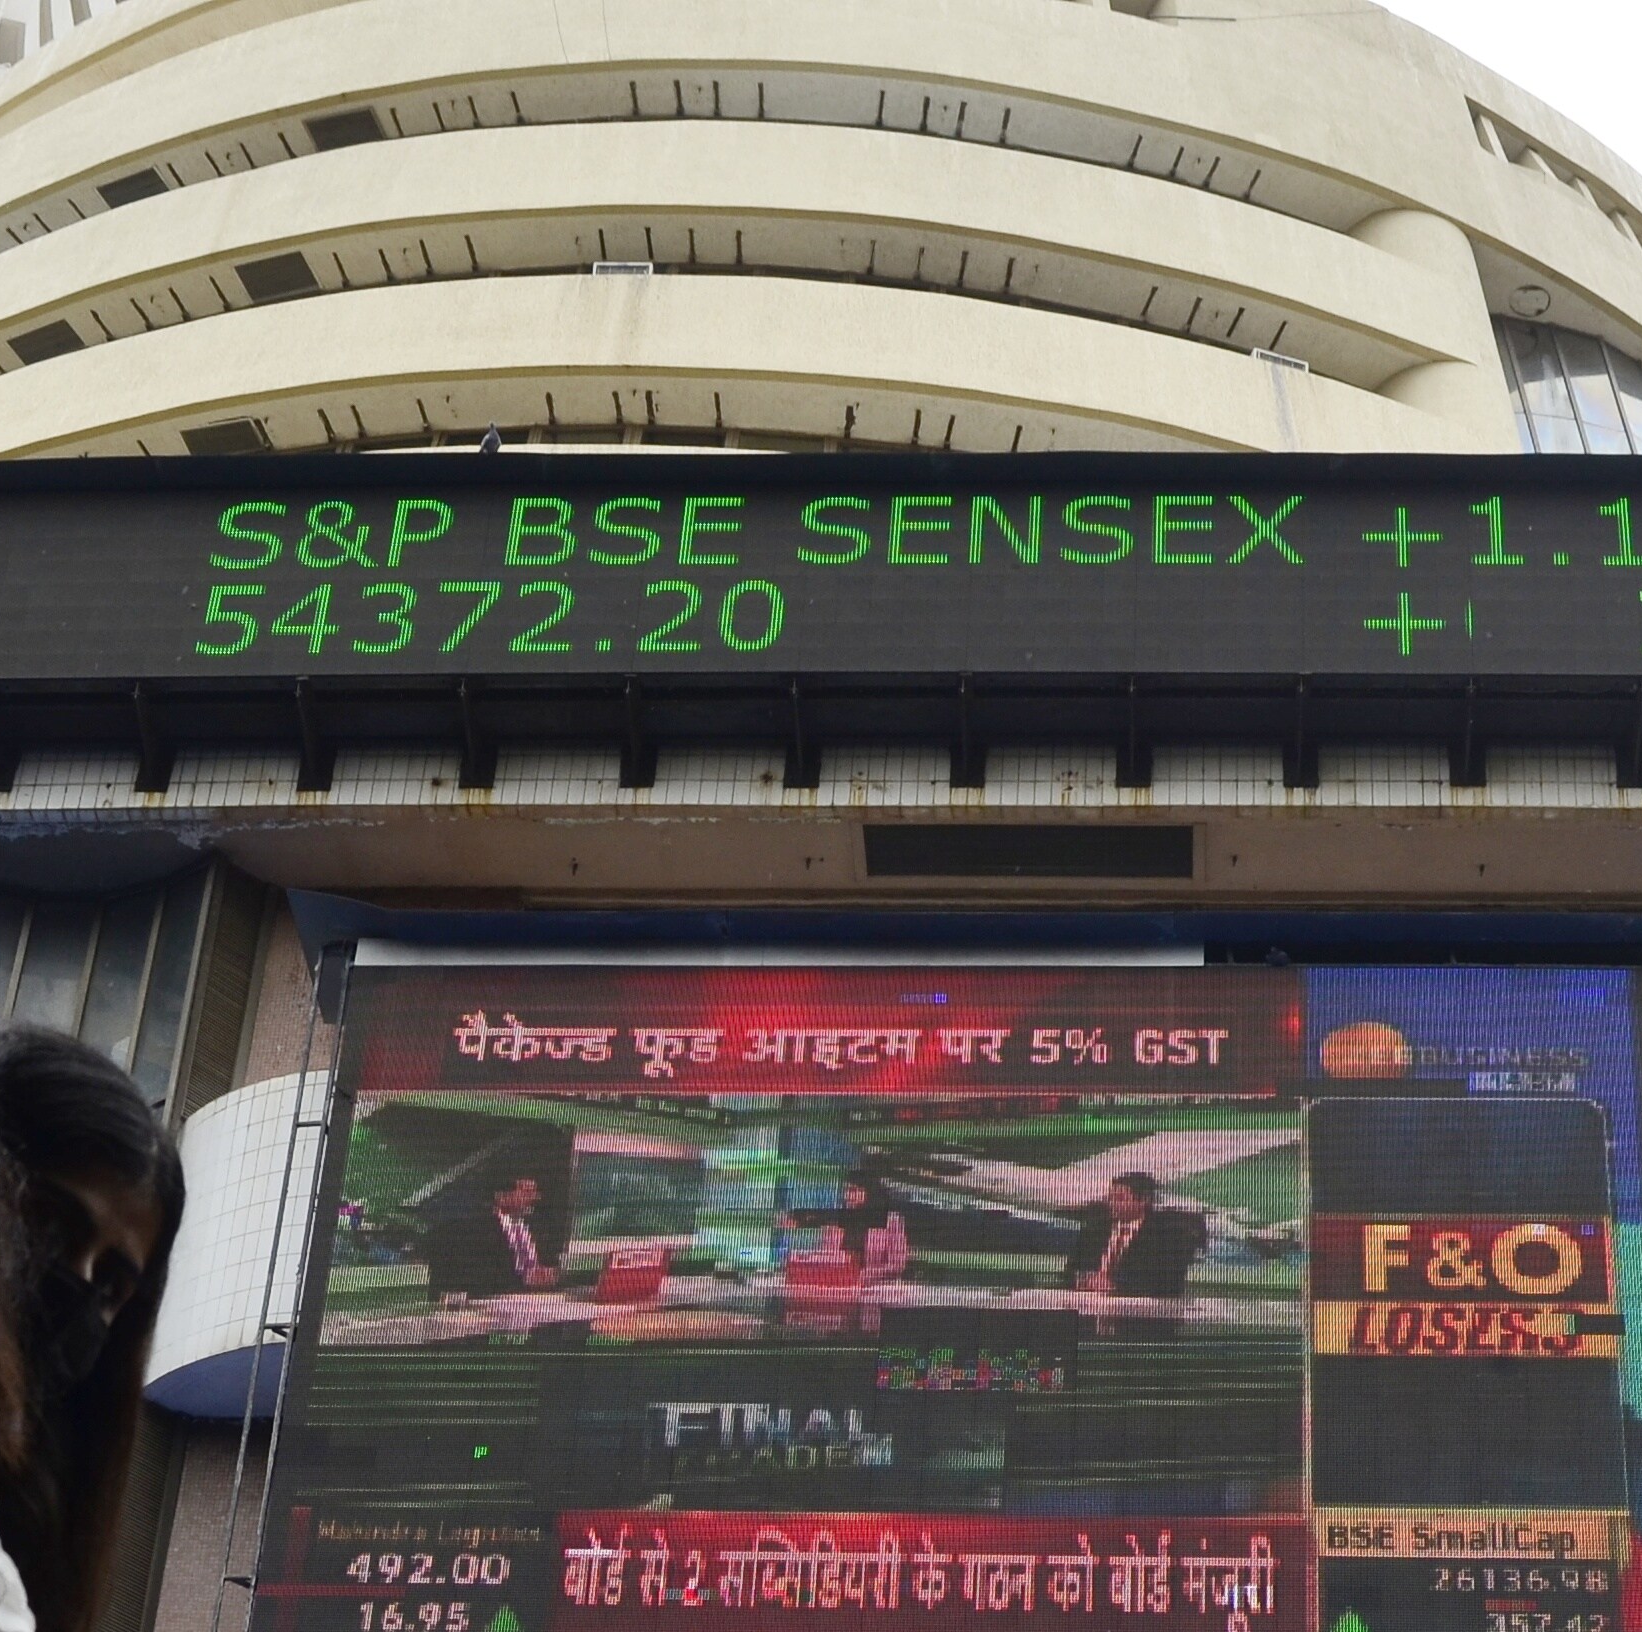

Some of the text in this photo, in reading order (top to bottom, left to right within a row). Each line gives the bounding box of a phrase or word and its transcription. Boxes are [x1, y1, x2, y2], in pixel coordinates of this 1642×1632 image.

[209, 498, 455, 570] S&P
[504, 496, 746, 566] BSE
[797, 494, 1305, 565] SENSEX
[194, 579, 785, 655] 54372.20
[453, 1009, 1230, 1078] पैकेज्ड फूड आइटम पर 5% GST
[1362, 1223, 1585, 1295] F&O
[346, 1552, 510, 1585] 492.00
[1327, 1520, 1576, 1557] BSE SmallCap
[360, 1601, 471, 1632] 16.95
